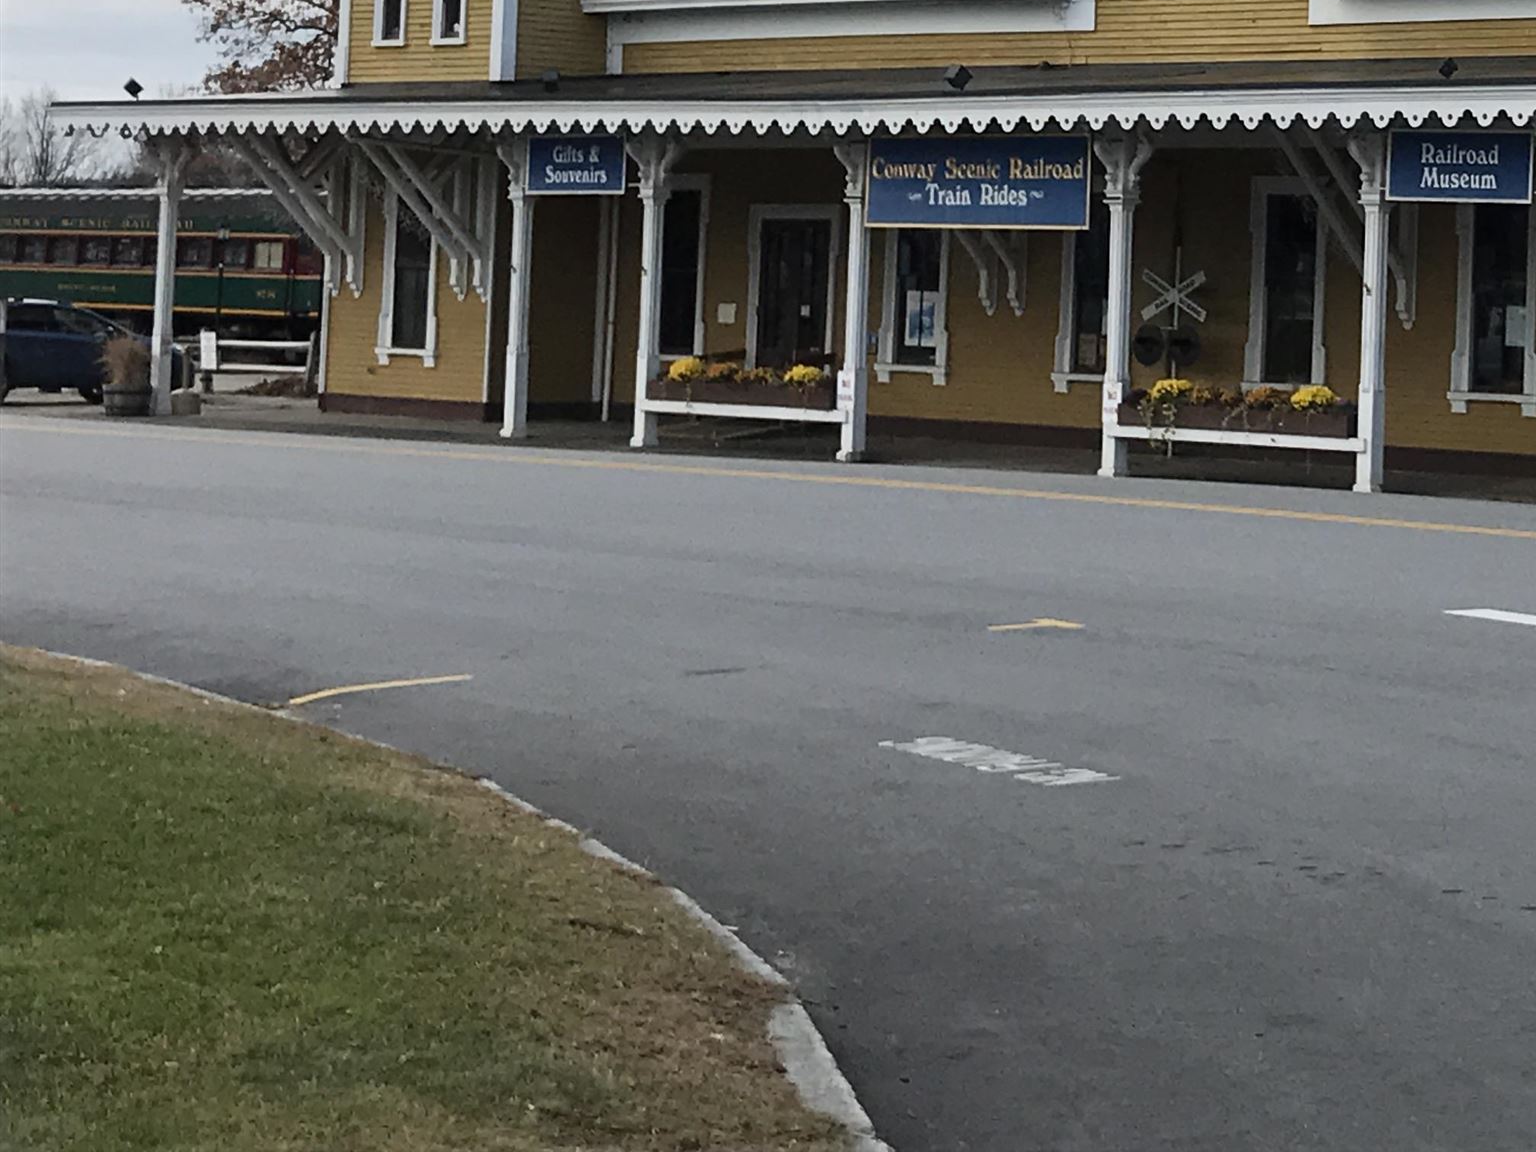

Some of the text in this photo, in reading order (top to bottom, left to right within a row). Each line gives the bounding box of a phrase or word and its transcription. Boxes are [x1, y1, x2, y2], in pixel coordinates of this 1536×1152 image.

[552, 145, 600, 163] Gifts &
[1421, 142, 1499, 165] Railroad
[545, 165, 608, 184] Souvenirs
[872, 157, 1084, 182] Conway Scenic Railroad
[1420, 167, 1497, 189] Museum
[925, 183, 1028, 206] Train Rides
